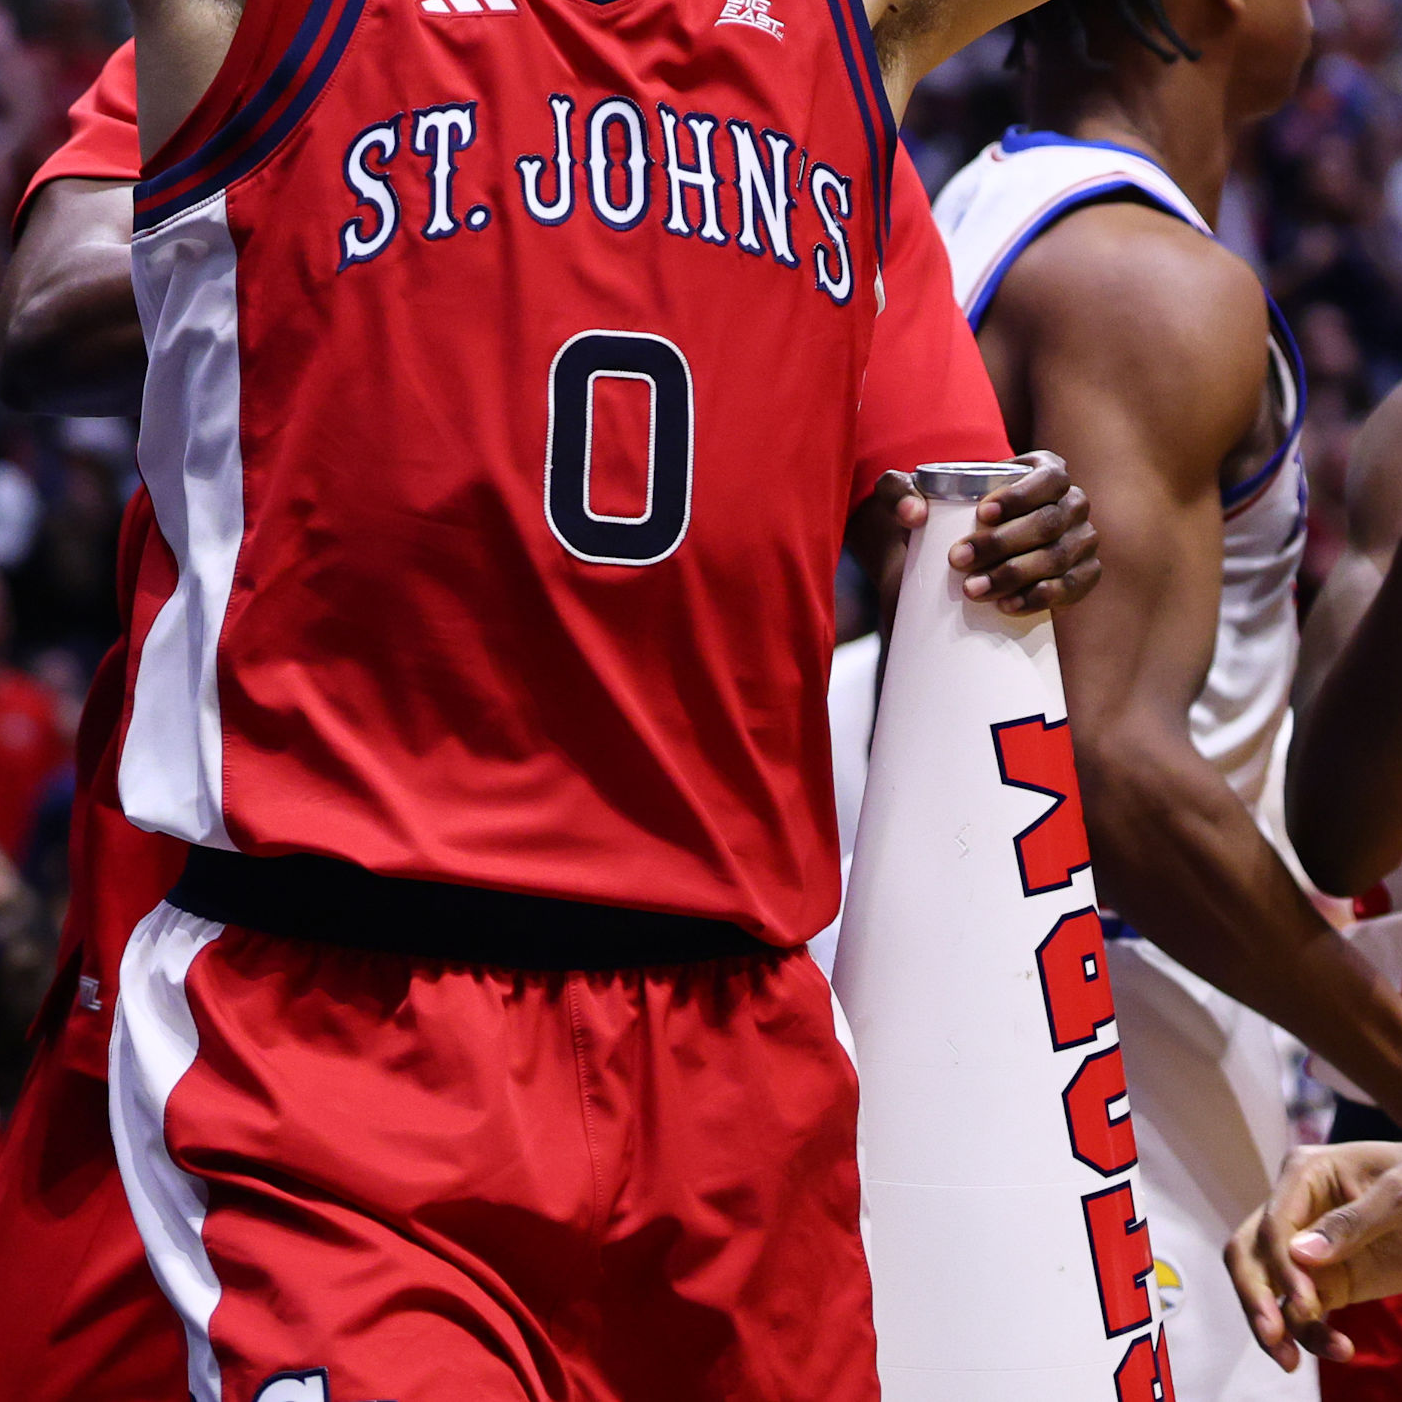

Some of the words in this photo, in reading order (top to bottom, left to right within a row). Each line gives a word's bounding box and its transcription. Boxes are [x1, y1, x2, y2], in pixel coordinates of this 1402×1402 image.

[720, 4, 785, 34] EAST
[338, 101, 491, 274] ST.
[515, 93, 853, 306] JOHN'S
[544, 329, 695, 565] 0
